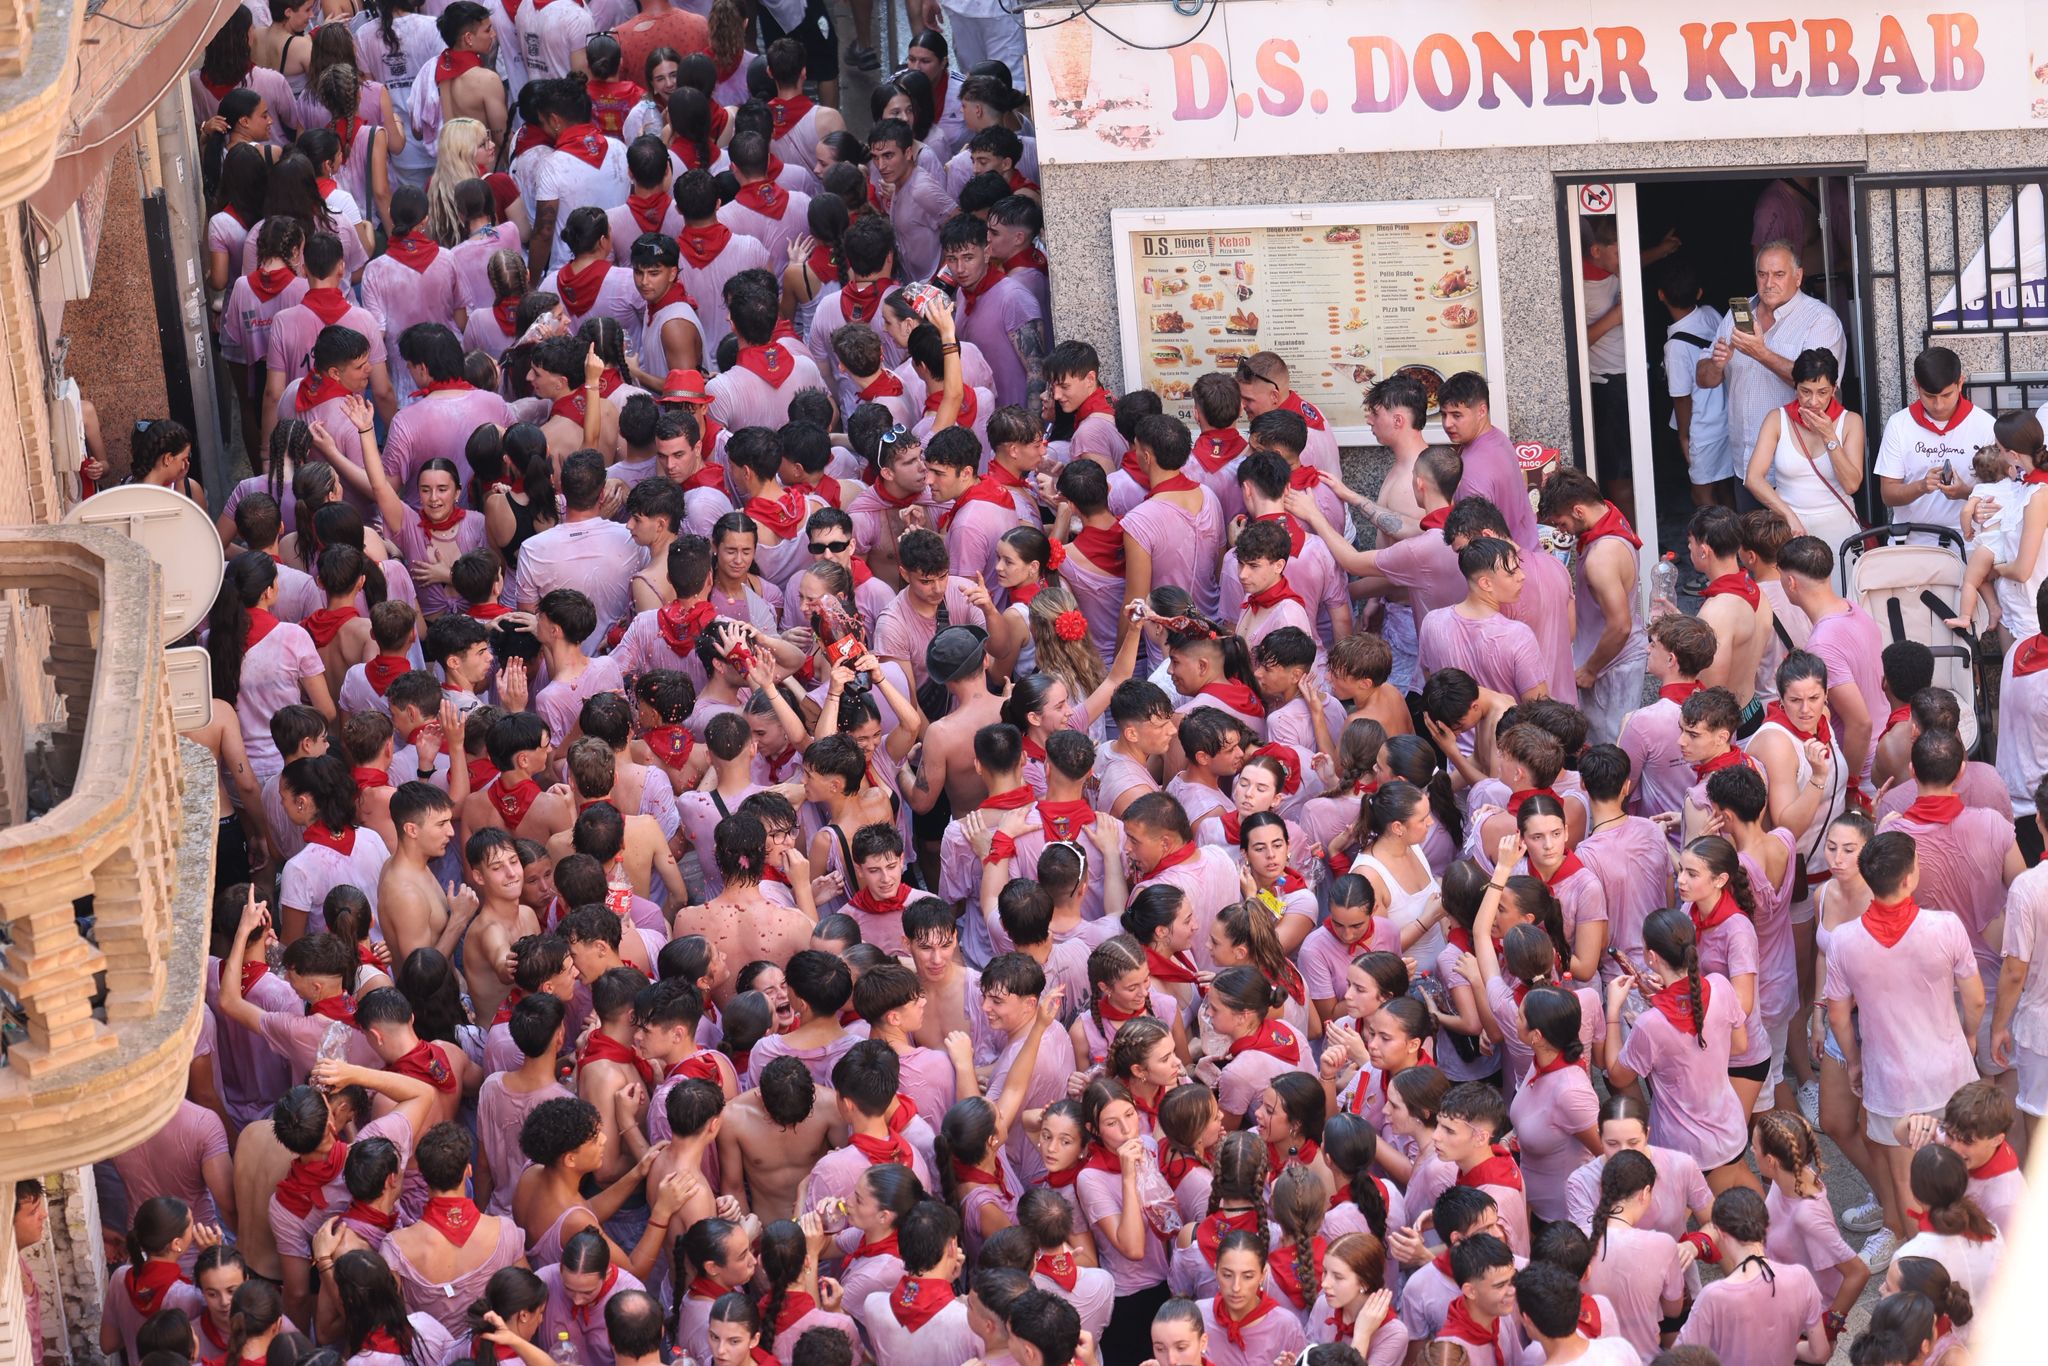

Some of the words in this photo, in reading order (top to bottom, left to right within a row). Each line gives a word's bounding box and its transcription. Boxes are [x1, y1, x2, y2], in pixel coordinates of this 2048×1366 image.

[1167, 38, 1329, 121] D.S.
[1347, 26, 1657, 113] DONER
[1679, 12, 1985, 101] KEBAB
[1143, 236, 1174, 256] D.S.
[1219, 236, 1251, 248] Kebab
[1178, 410, 1192, 419] 94
[1915, 441, 1938, 457] Pepe
